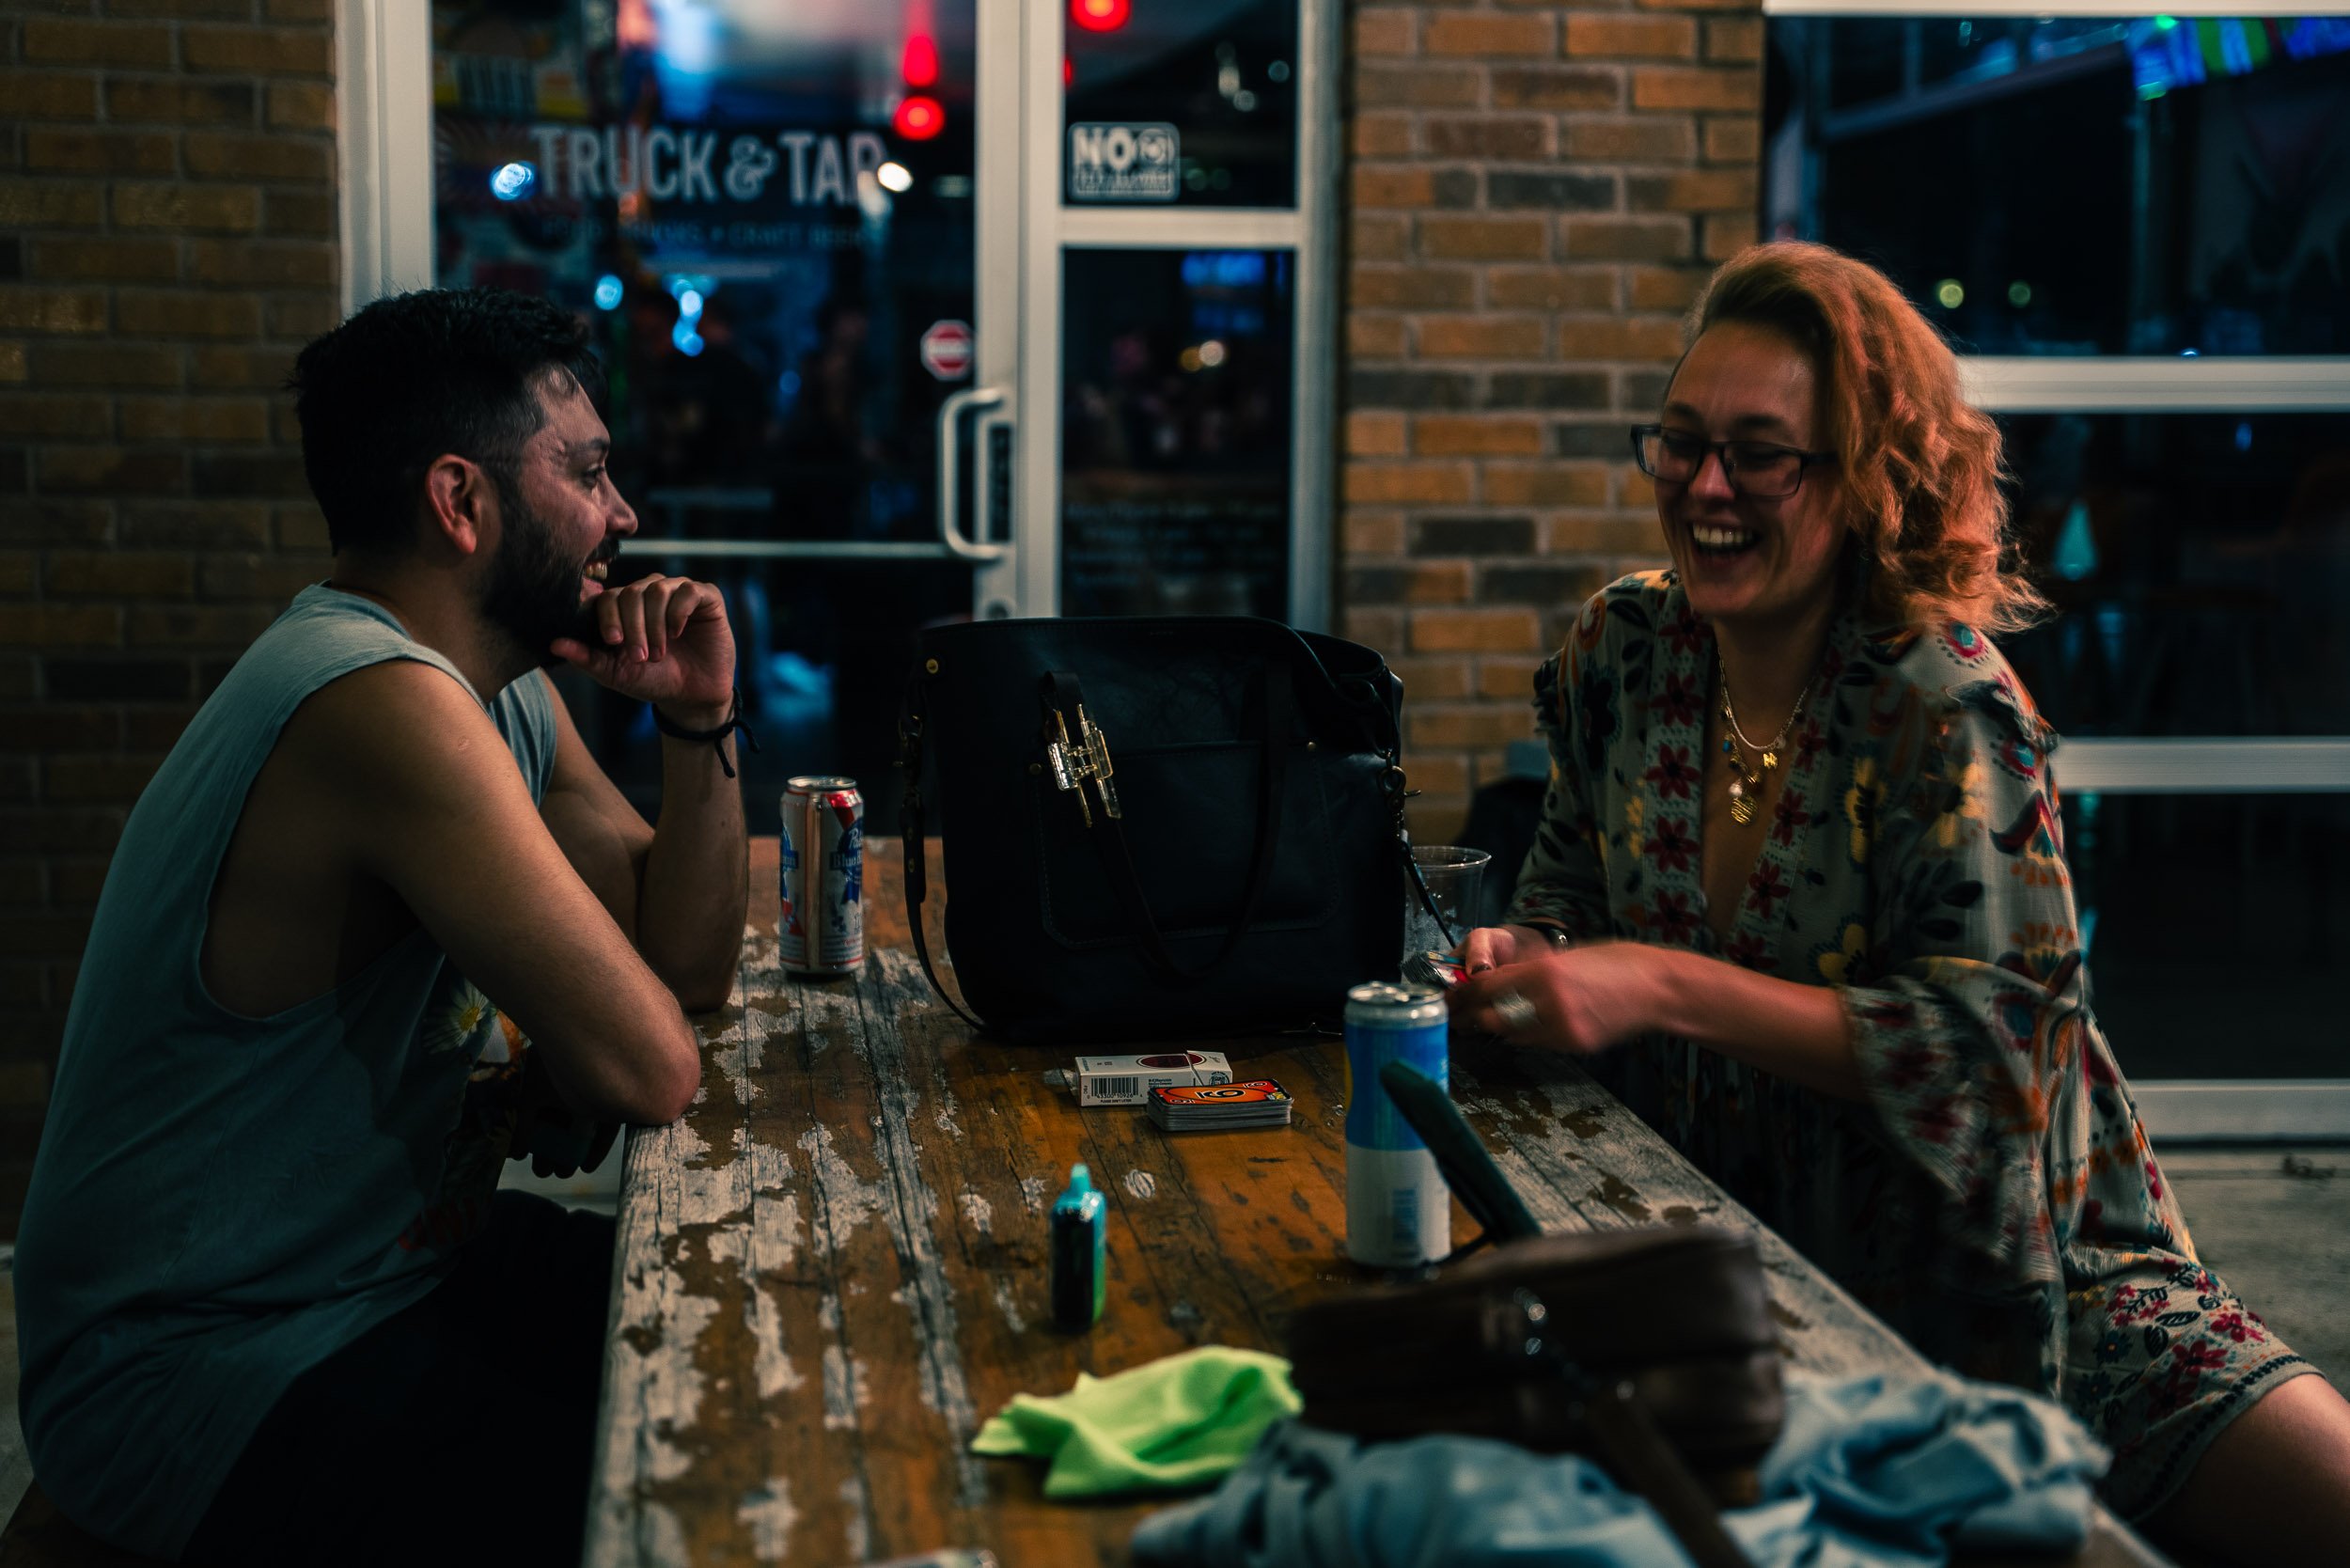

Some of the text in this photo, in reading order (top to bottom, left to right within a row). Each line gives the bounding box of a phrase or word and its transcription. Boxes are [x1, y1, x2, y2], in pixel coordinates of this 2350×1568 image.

[528, 124, 887, 209] TRUCK & TAP
